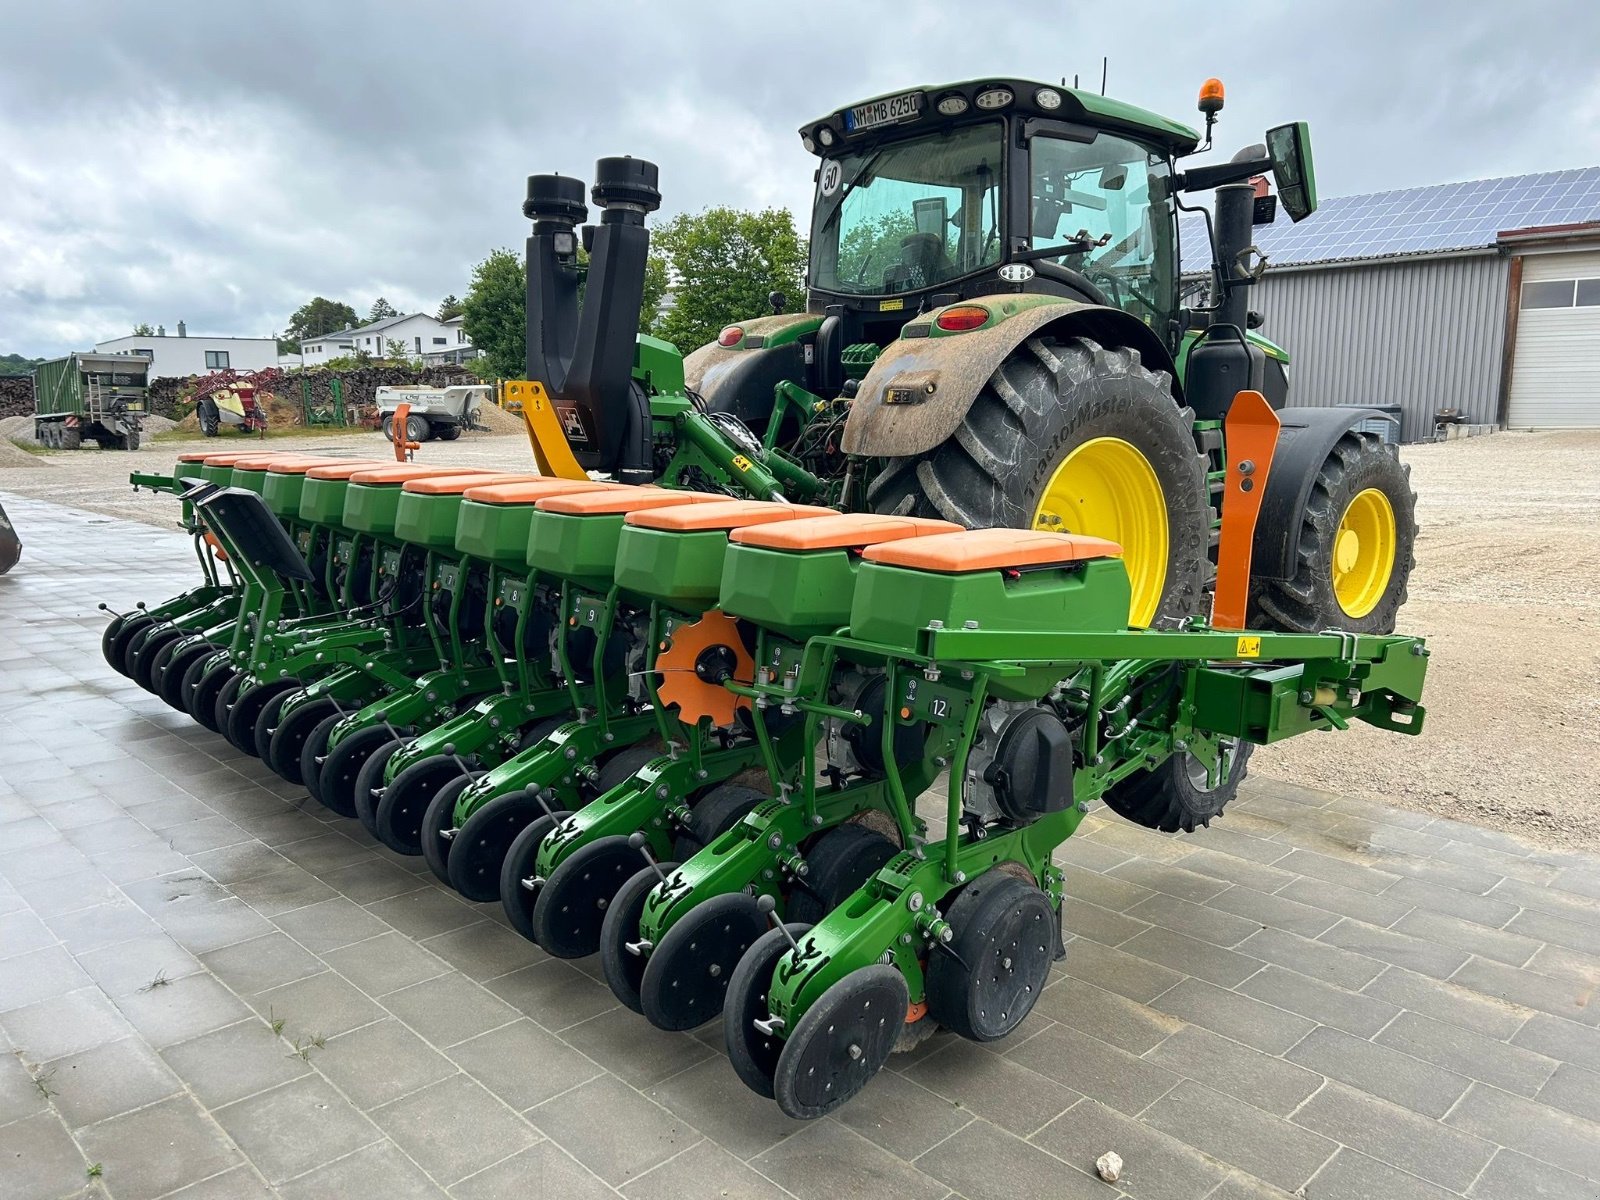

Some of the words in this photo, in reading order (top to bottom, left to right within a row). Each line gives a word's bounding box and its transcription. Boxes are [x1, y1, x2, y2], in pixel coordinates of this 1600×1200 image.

[853, 108, 867, 127] NM
[873, 103, 888, 121] MB
[890, 95, 917, 117] 6250
[824, 166, 837, 190] 50
[448, 575, 453, 585] 7
[512, 590, 518, 601] 8
[588, 609, 595, 621] 9
[933, 699, 946, 717] 12
